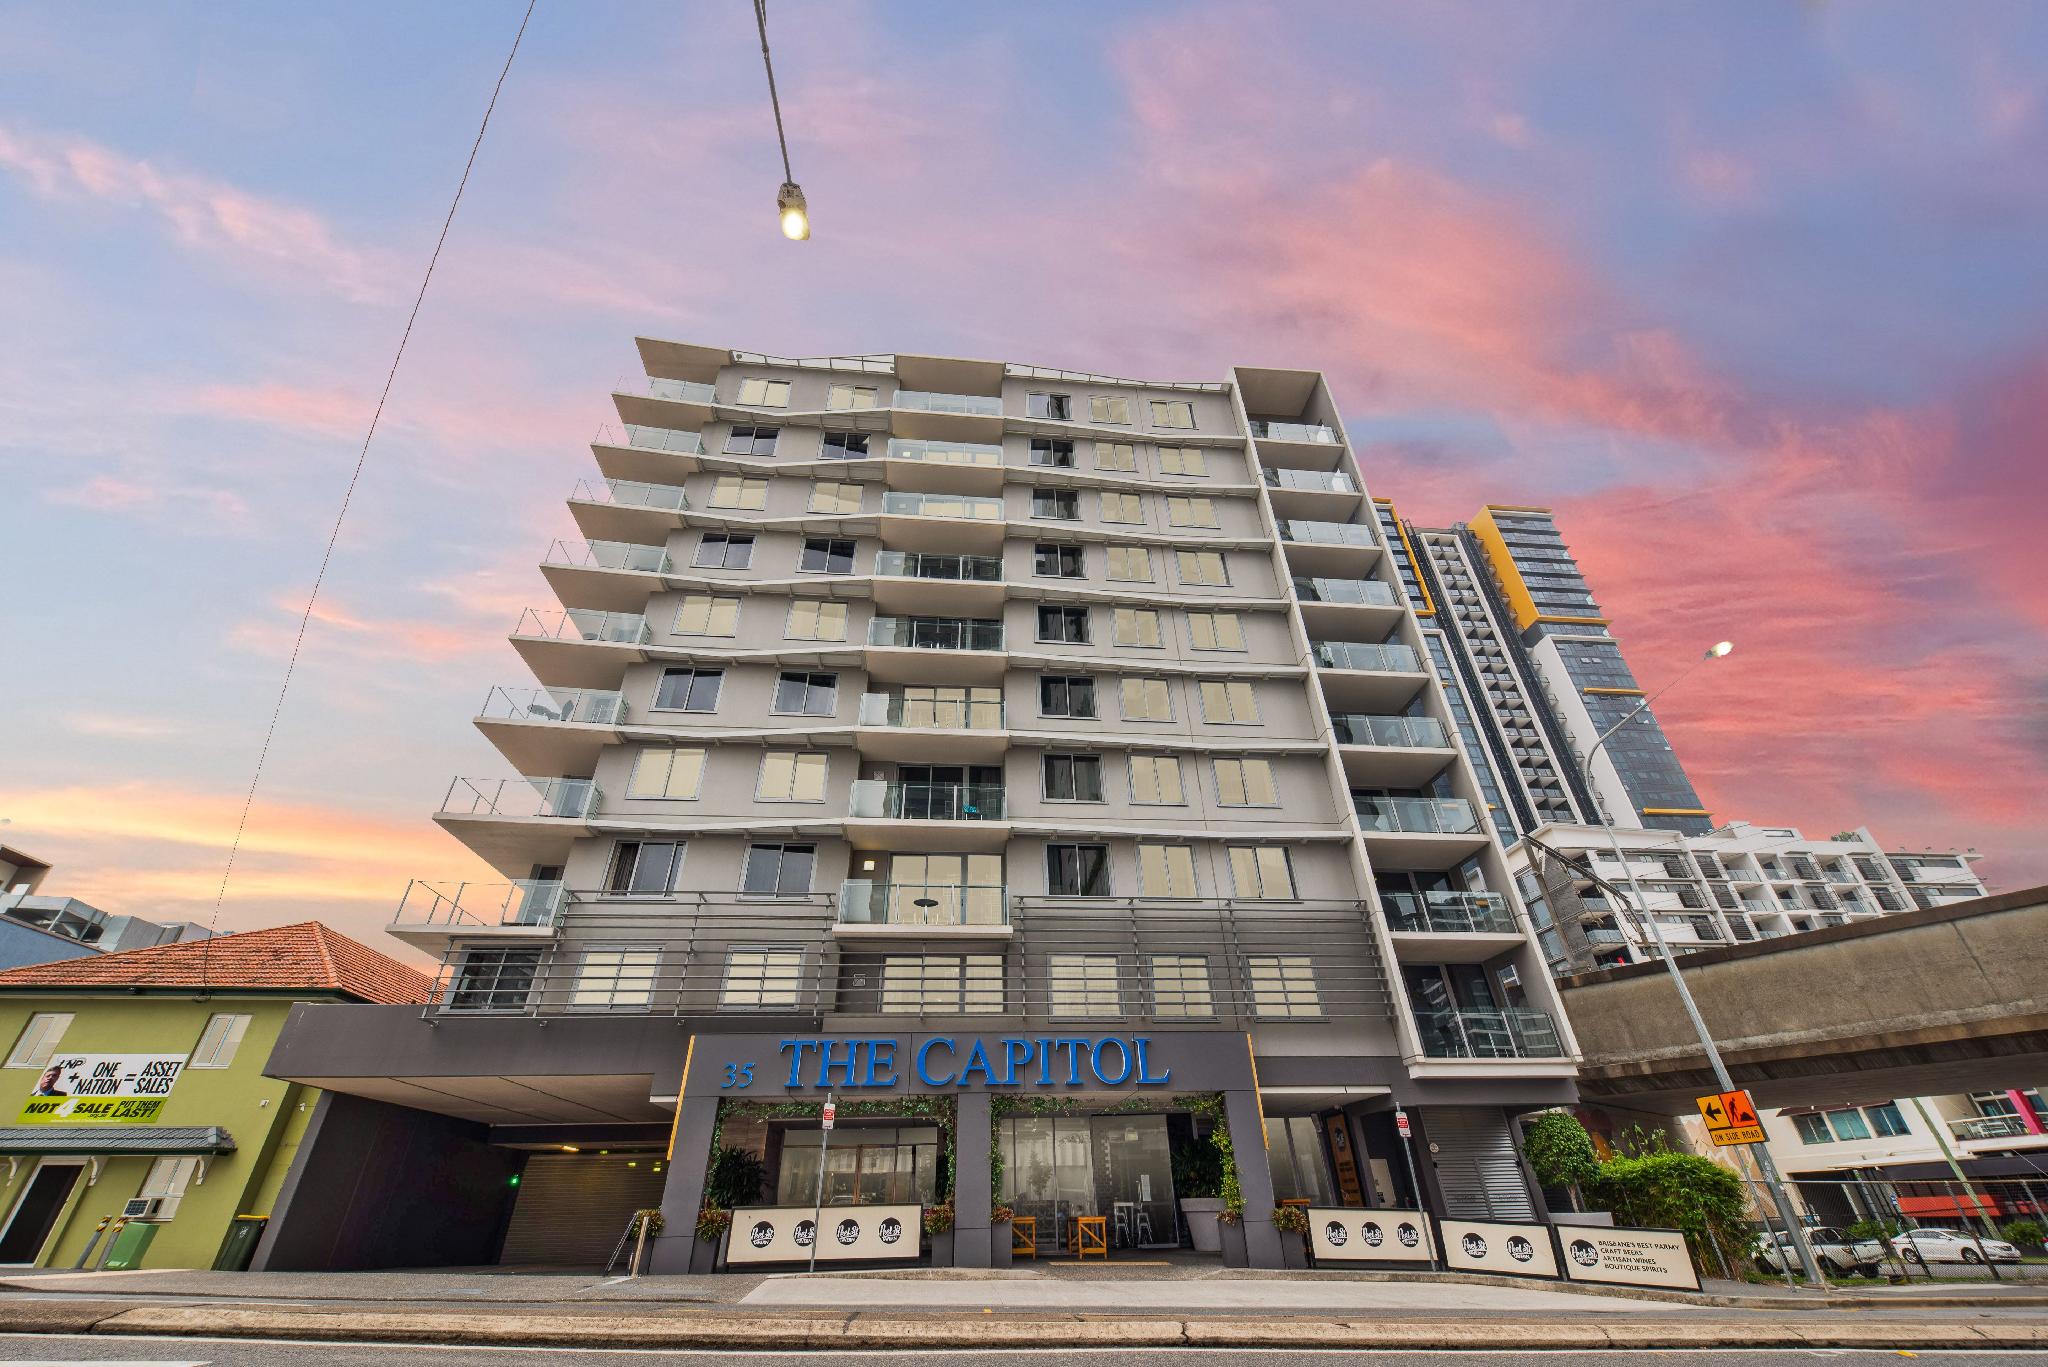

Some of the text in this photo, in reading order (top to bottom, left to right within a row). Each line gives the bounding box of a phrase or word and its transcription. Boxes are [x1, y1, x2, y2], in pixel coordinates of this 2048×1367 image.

[59, 1060, 84, 1069] LNP
[779, 1037, 1171, 1087] THE CAPITOL
[93, 1062, 122, 1078] ONE
[141, 1061, 183, 1077] ASSET
[720, 1062, 756, 1089] 35
[73, 1079, 124, 1094] NATION
[134, 1078, 173, 1094] SALES
[24, 1098, 114, 1117] NOT 4 SALE
[136, 1101, 162, 1109] THEM
[110, 1108, 156, 1118] LAST!
[1714, 1130, 1760, 1142] ON SIDE ROAD
[1598, 1240, 1636, 1248] BRISBANE'S
[1654, 1243, 1680, 1251] PARMY
[1633, 1257, 1656, 1265] WINES
[1605, 1263, 1668, 1273] BOUTIQUE SPIRITS
